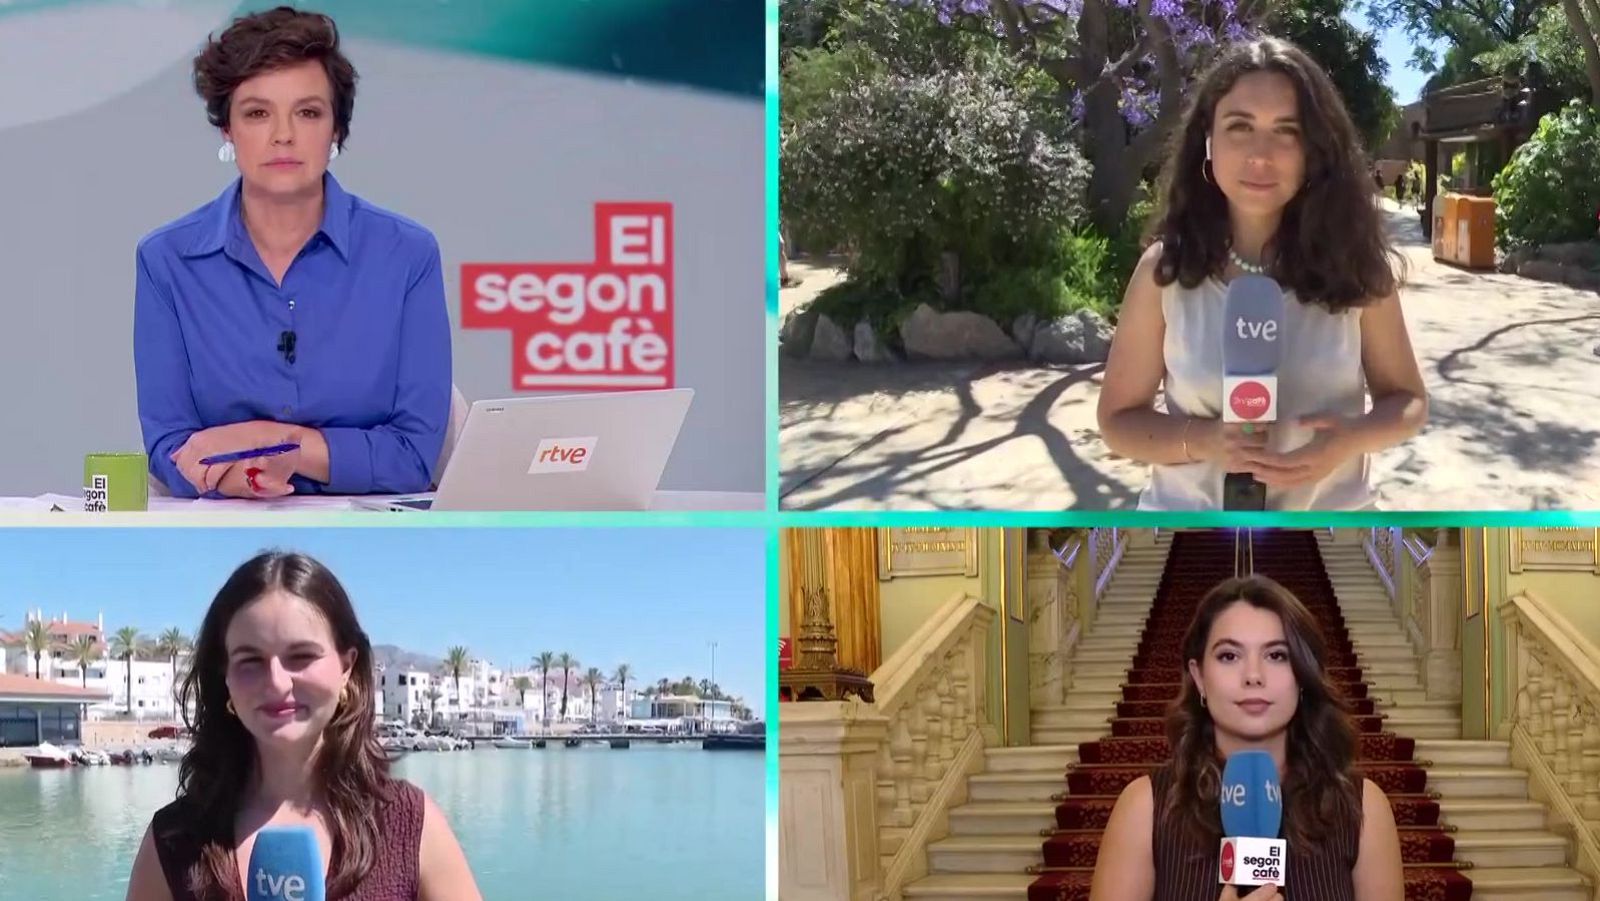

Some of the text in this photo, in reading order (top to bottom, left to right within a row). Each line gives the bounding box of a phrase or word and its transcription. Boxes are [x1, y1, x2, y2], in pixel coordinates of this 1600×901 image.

[610, 215, 664, 265] El
[475, 273, 666, 325] segon
[1236, 316, 1278, 341] tve
[525, 317, 668, 371] cafè
[539, 445, 587, 464] rtve
[94, 478, 105, 489] El
[1265, 779, 1283, 808] tv
[1243, 856, 1280, 868] segon
[1269, 846, 1280, 857] El
[255, 867, 305, 901] tve
[1252, 866, 1280, 878] cafè
